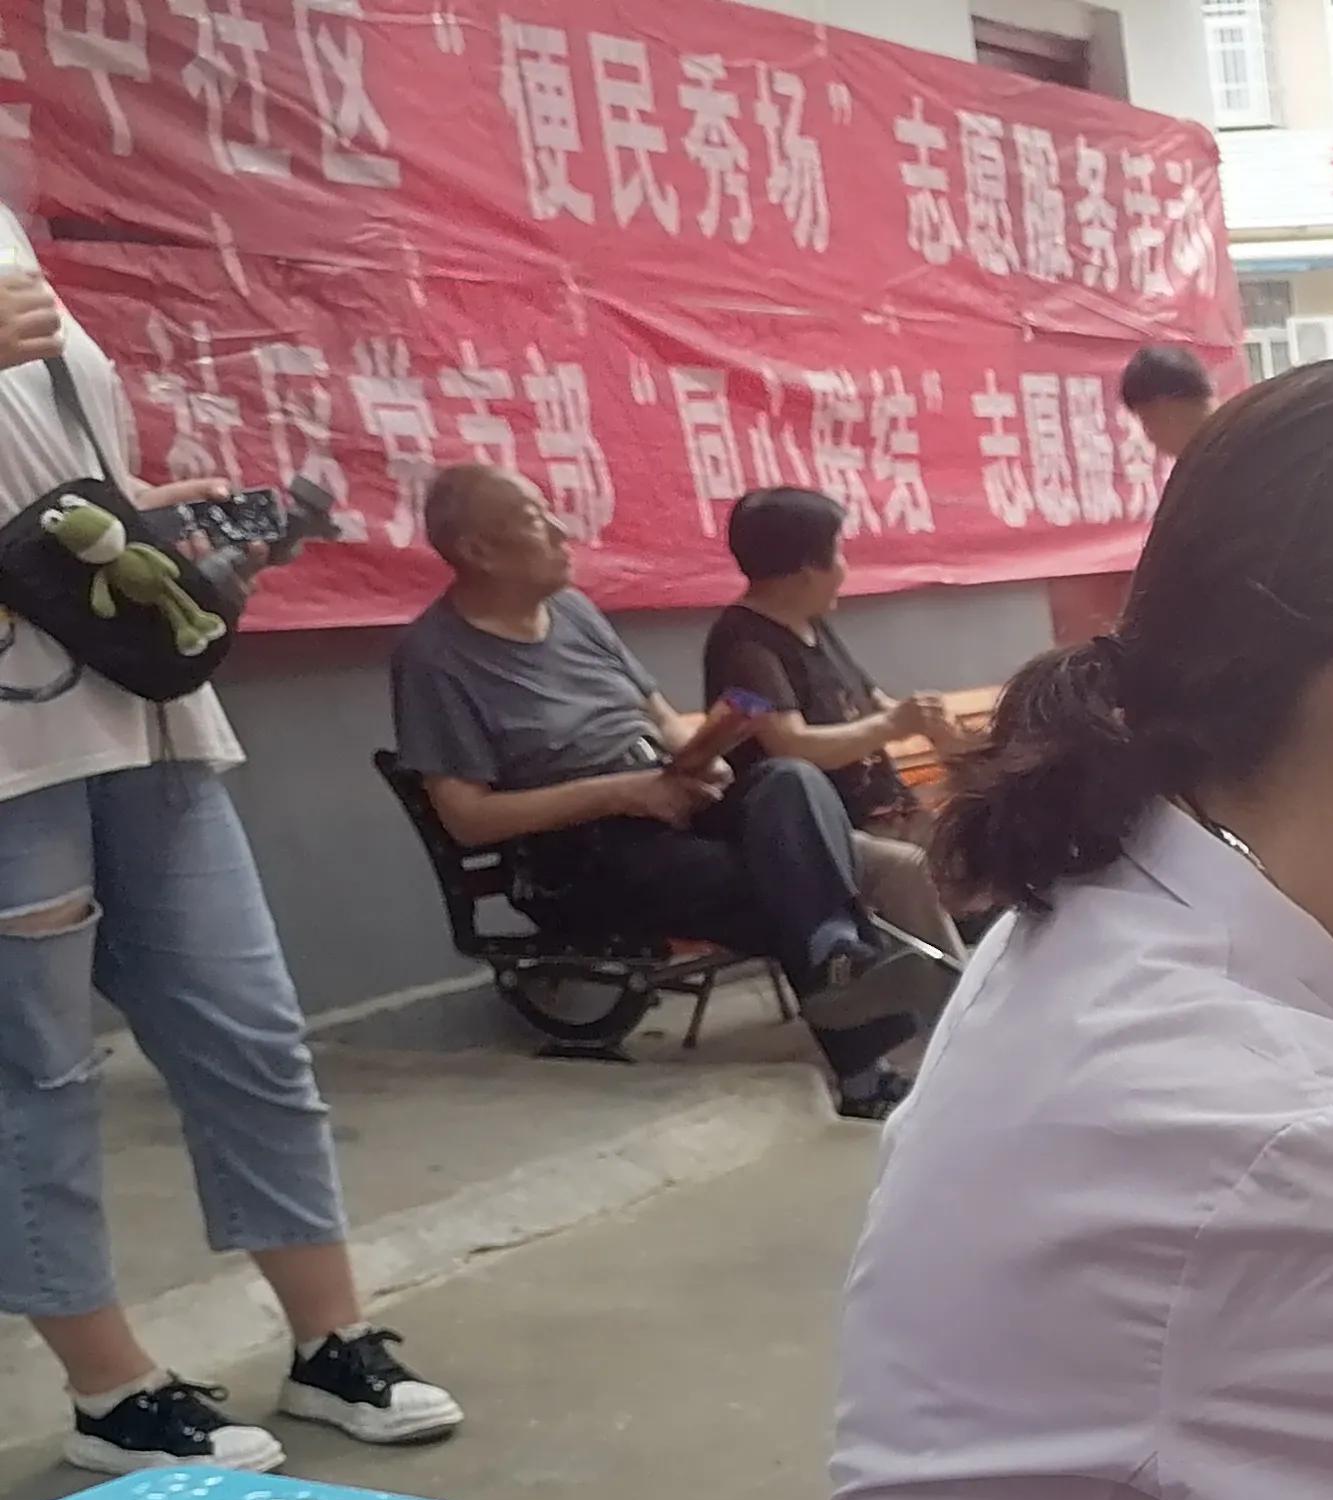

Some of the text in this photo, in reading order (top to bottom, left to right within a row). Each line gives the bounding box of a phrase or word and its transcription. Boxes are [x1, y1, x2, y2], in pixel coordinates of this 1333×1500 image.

[892, 98, 1220, 300] 志愿服务活动
[970, 368, 1175, 528] 志愿服务
